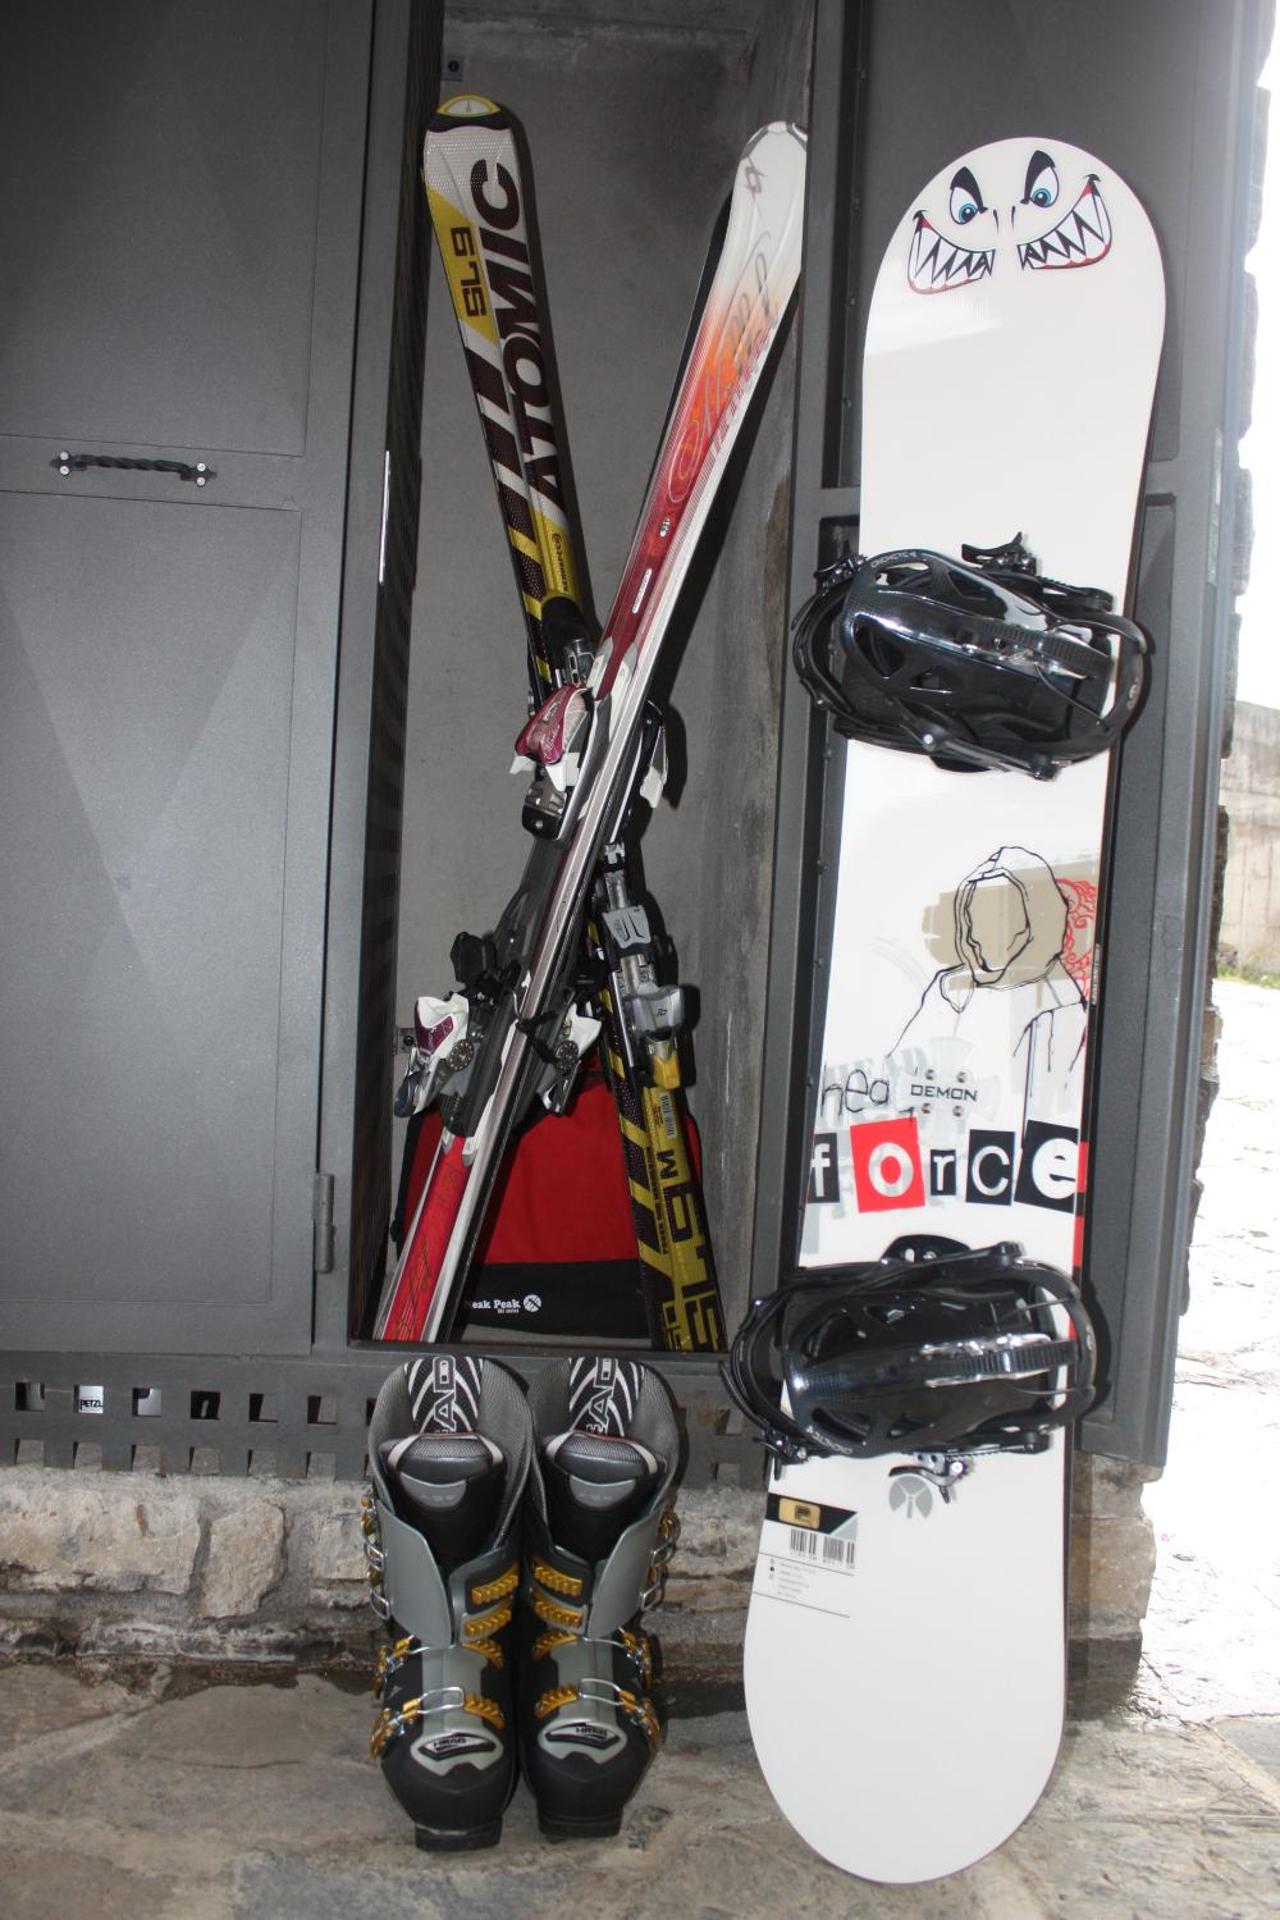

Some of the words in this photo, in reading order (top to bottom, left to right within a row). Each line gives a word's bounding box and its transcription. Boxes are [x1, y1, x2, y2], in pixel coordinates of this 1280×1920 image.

[470, 159, 563, 514] ATOMIC
[911, 1084, 978, 1102] DEMON
[811, 1136, 1078, 1201] force
[493, 1299, 521, 1309] Peak
